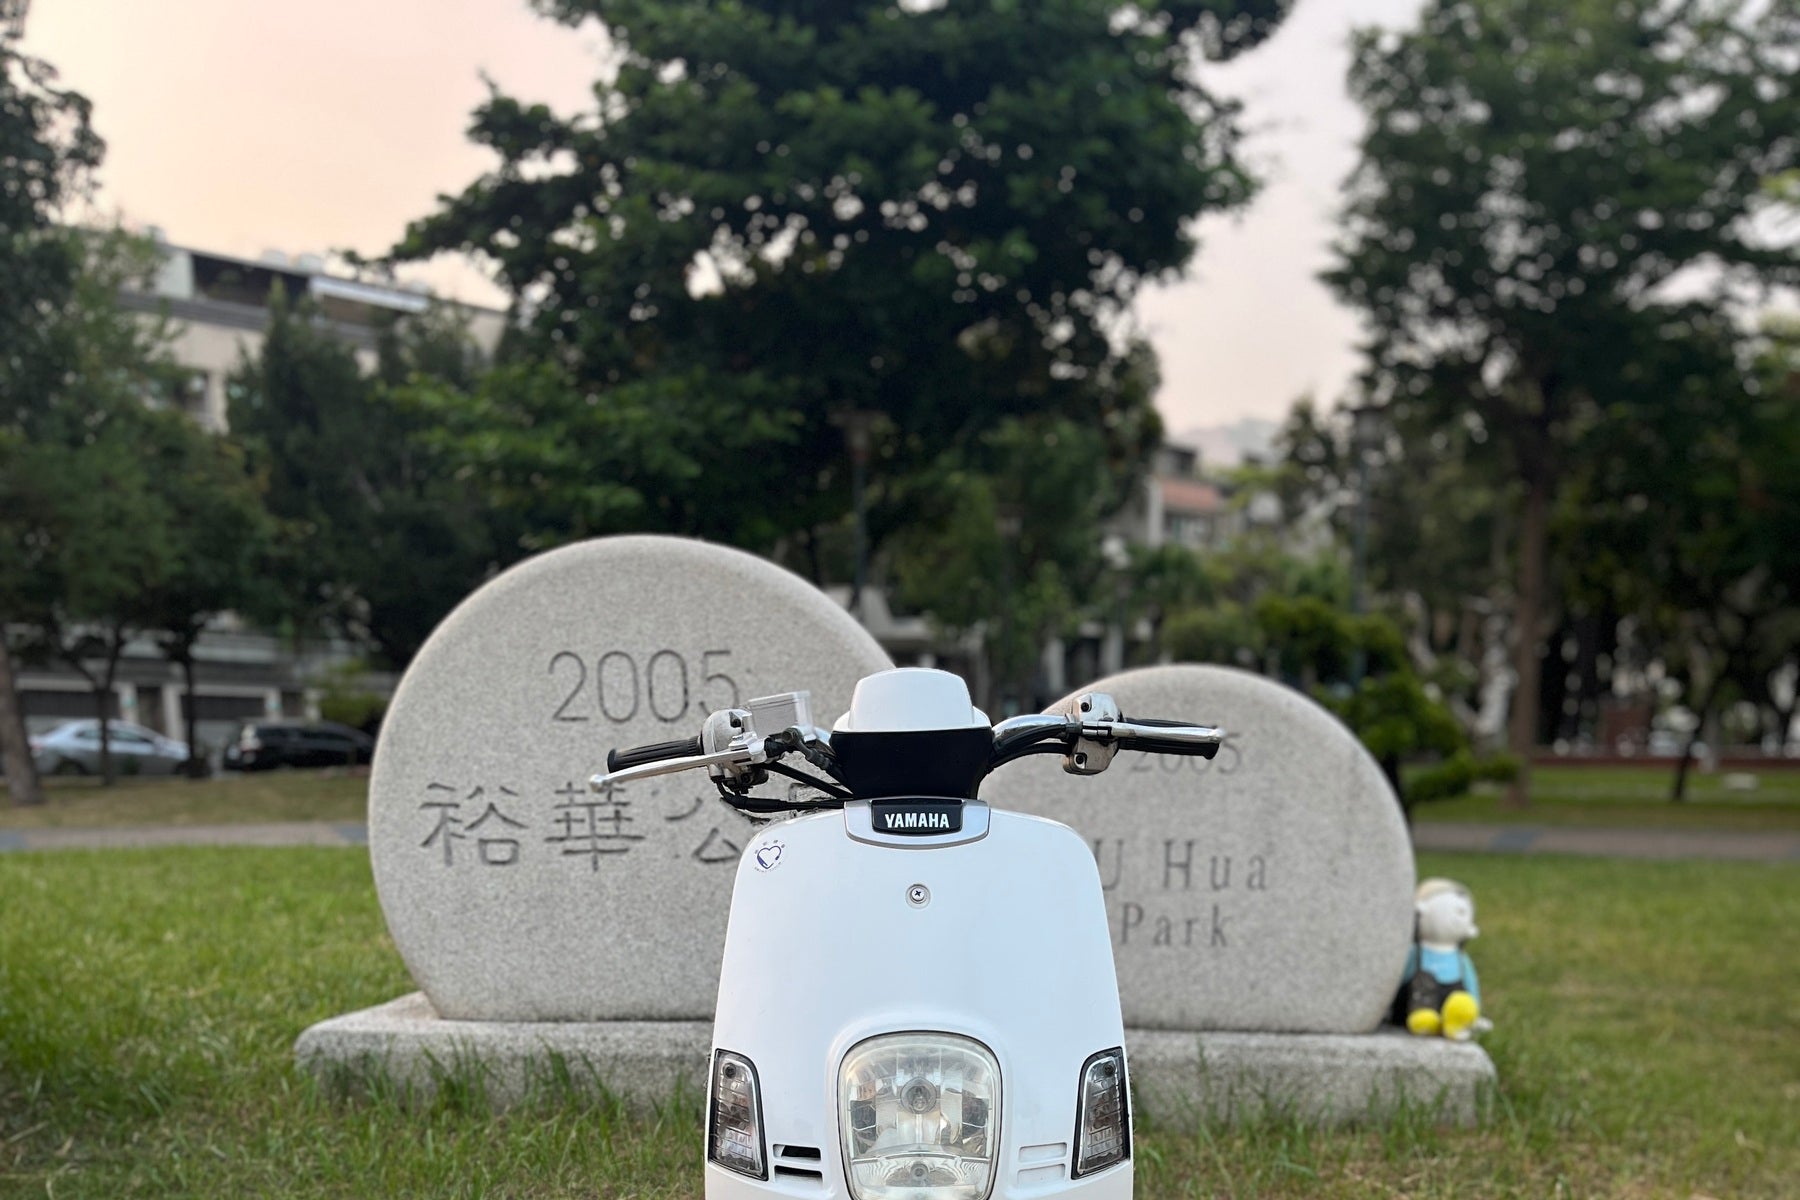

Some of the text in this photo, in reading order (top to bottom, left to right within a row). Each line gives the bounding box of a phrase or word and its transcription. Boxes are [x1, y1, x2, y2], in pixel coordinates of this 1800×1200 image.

[549, 648, 740, 723] 2005
[419, 781, 842, 872] 裕華公
[884, 812, 950, 829] YAMAHA
[1162, 838, 1268, 891] Hua
[1119, 902, 1232, 947] Park
